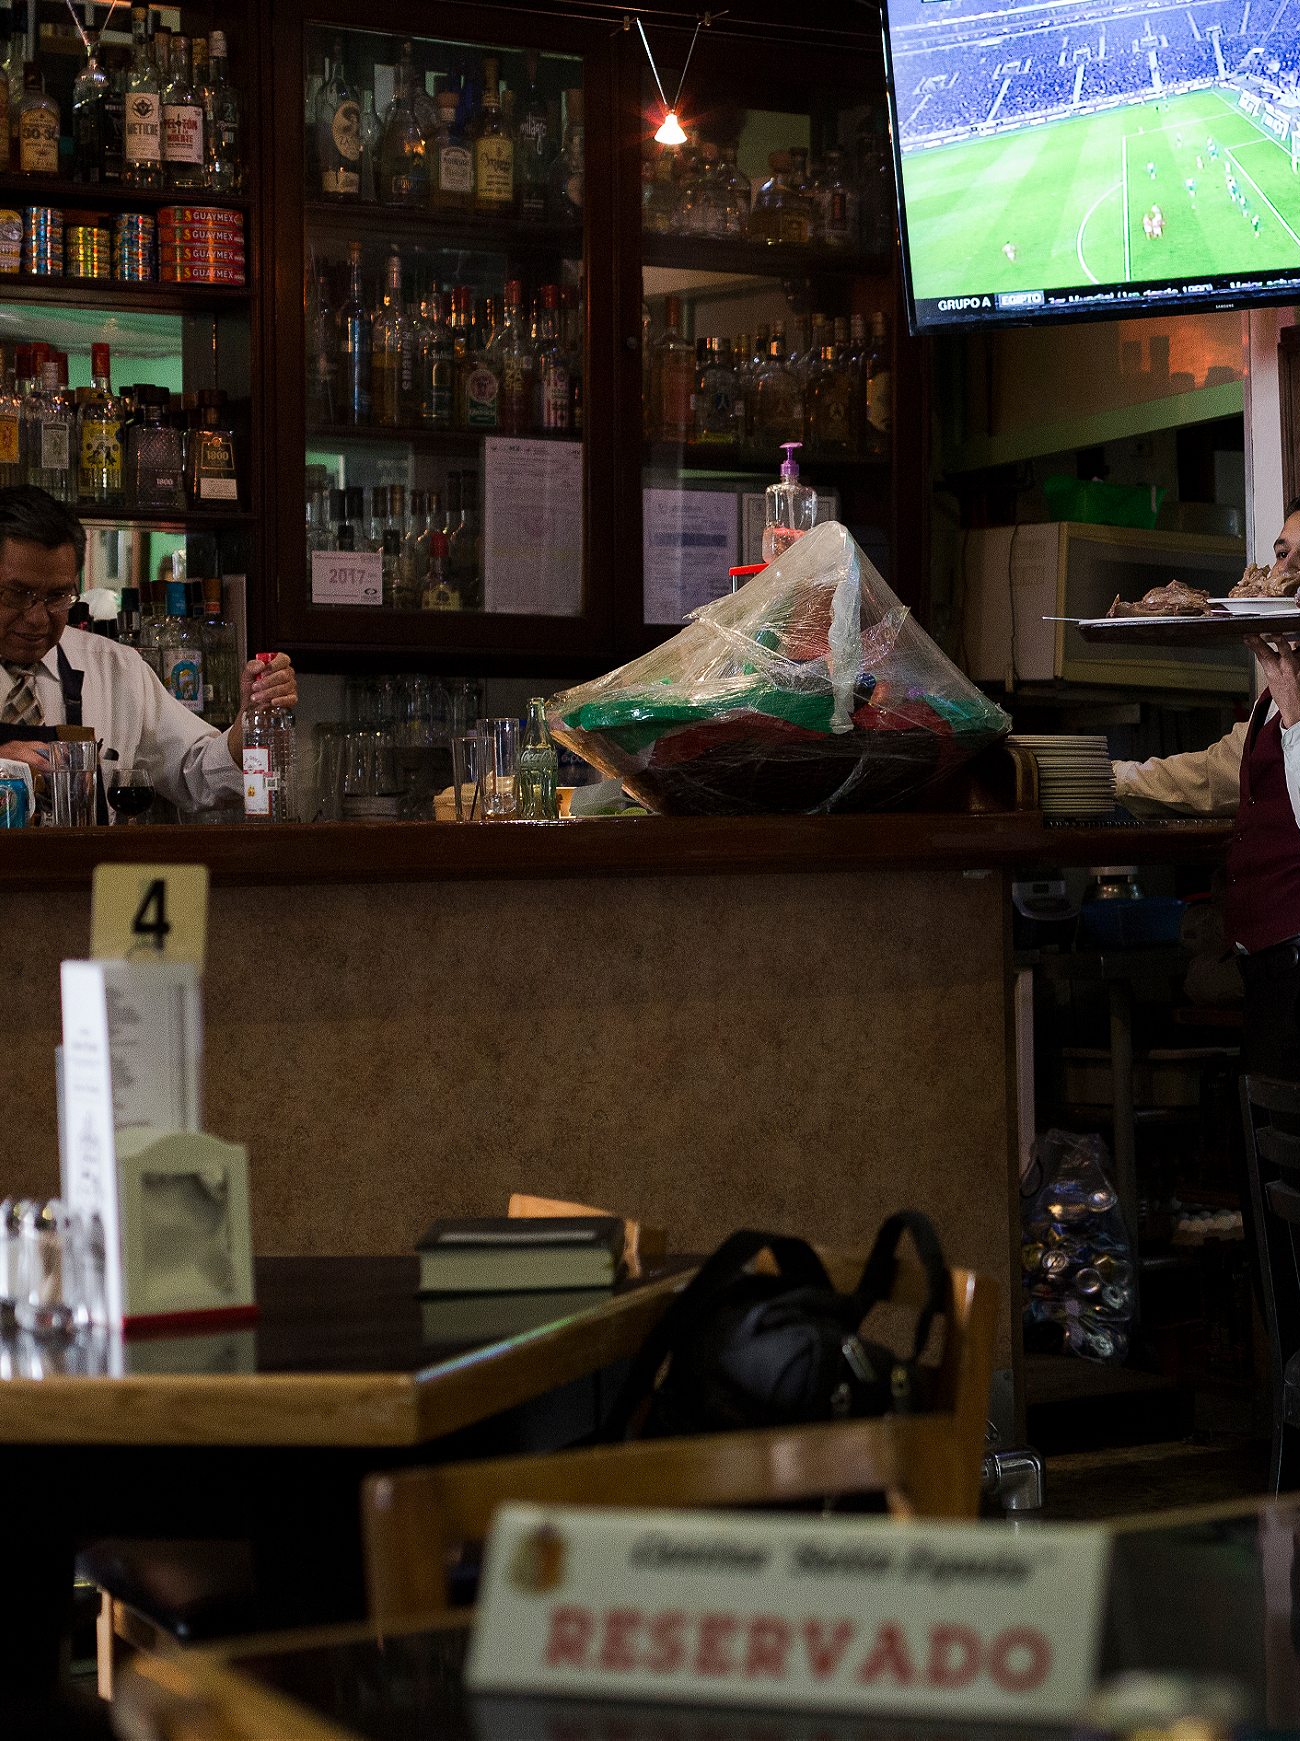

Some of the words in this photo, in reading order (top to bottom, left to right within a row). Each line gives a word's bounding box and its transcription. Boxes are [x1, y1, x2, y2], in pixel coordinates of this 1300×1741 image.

[192, 211, 233, 222] GUAYMEX
[192, 230, 233, 241] GUAYMEX
[192, 249, 234, 260] GUAYMEX
[192, 268, 234, 279] GUAYMEX
[937, 298, 980, 312] GRUPO
[981, 297, 992, 309] A
[207, 450, 229, 461] 1800
[132, 878, 171, 951] 4
[543, 1604, 1052, 1692] RESERVADO
